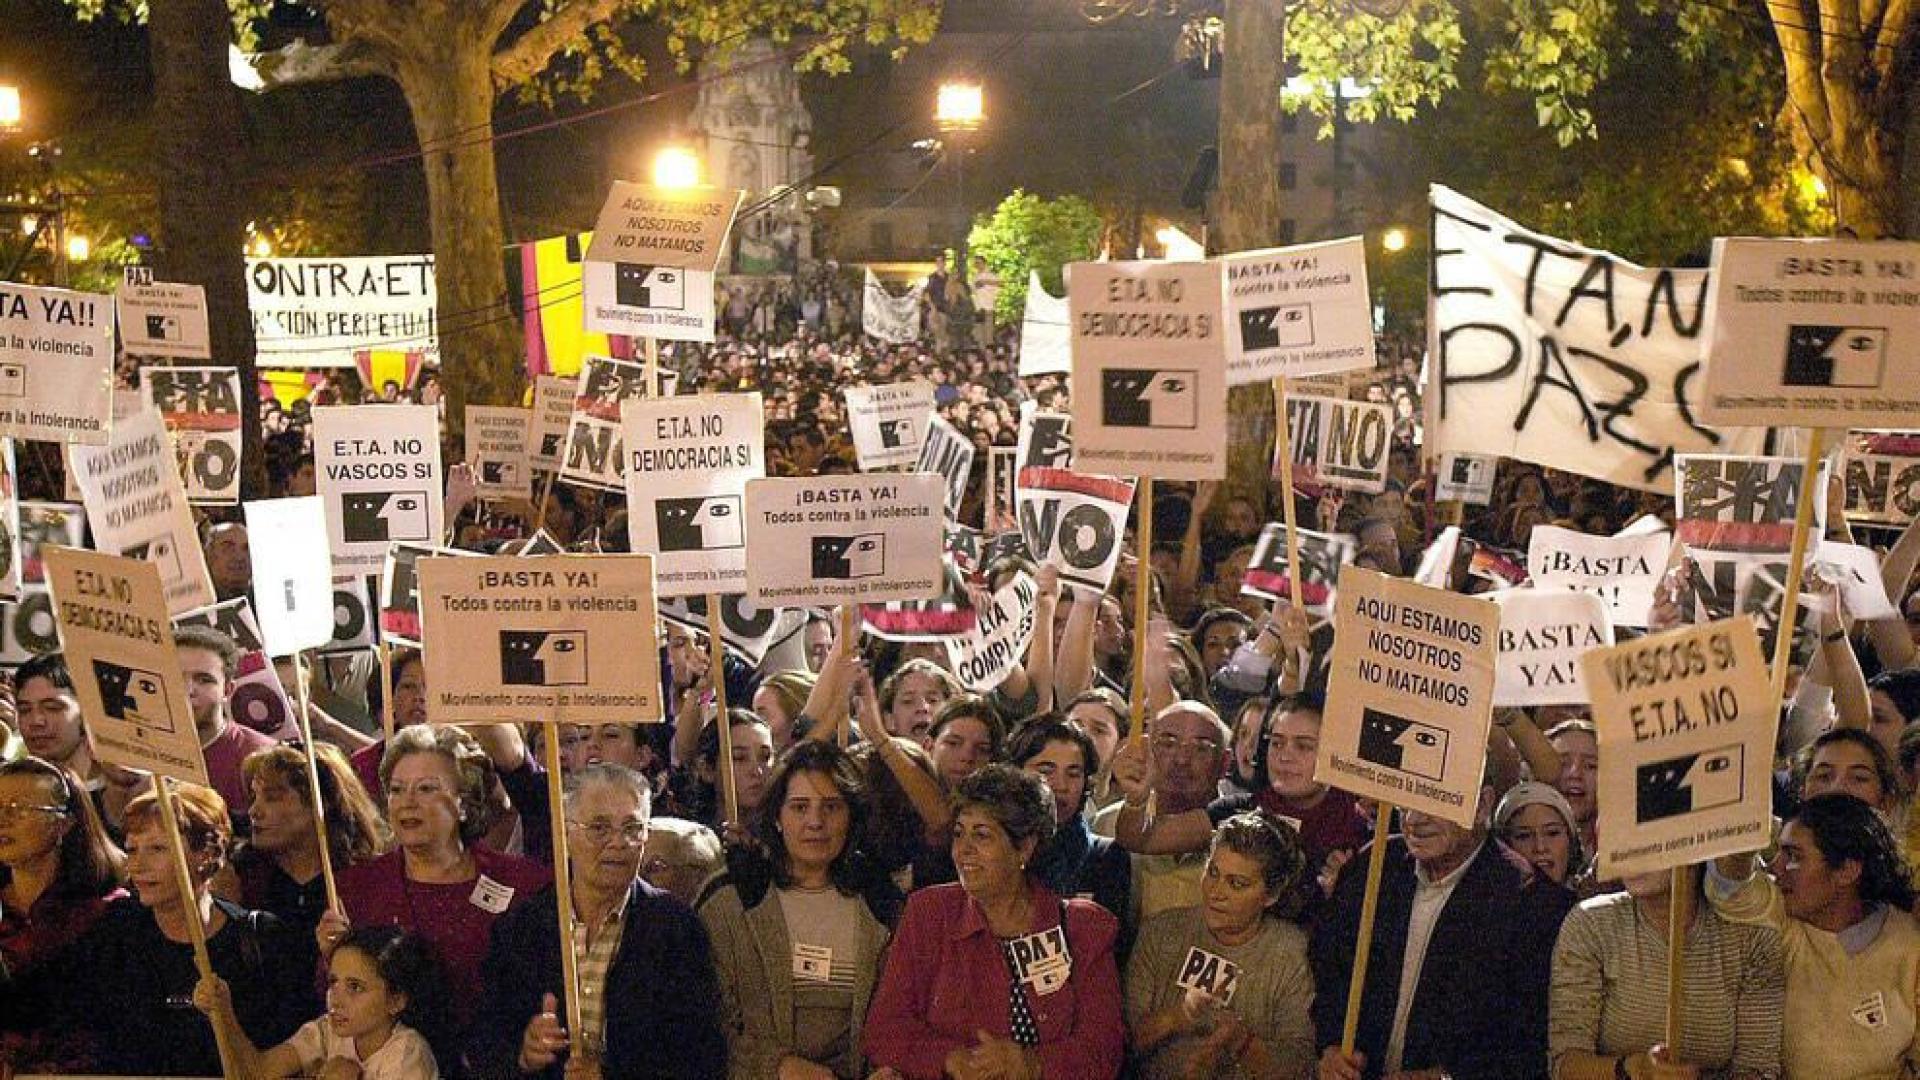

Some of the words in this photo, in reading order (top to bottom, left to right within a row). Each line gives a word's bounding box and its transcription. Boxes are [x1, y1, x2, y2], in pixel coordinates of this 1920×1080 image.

[627, 217, 704, 233] NOSOTROS
[615, 235, 635, 247] NO
[638, 237, 705, 252] MATAMOS
[1290, 256, 1318, 271] YA!
[126, 266, 152, 287] PAZ
[1157, 278, 1183, 302] NO
[41, 296, 94, 327] YA!!
[1081, 313, 1190, 337] DEMOCRACIA
[11, 334, 24, 349] la
[29, 337, 94, 357] violencia
[15, 408, 26, 425] la
[30, 411, 100, 431] Intolerancia
[656, 417, 697, 439] E.T.A.
[702, 415, 722, 436] NO
[334, 440, 387, 456] E.T.A.
[393, 439, 422, 455] NO
[1326, 404, 1386, 469] NO
[634, 445, 733, 472] DEMOCRACIA
[737, 444, 751, 466] SI
[326, 463, 408, 480] VASCOS
[415, 463, 432, 480] SI
[796, 489, 862, 507] ¡BASTA
[869, 486, 897, 499] YA!
[764, 511, 803, 524] Todos
[808, 509, 850, 523] contra
[855, 508, 866, 521] la
[871, 504, 930, 519] violencia
[1542, 551, 1651, 577] ¡BASTA
[478, 571, 555, 590] ¡BASTA
[565, 571, 598, 587] YA!
[759, 586, 819, 598] Movimiento
[824, 584, 856, 595] contra
[859, 582, 868, 592] la
[871, 580, 933, 592] Intolerancia
[441, 594, 489, 612] Todos
[493, 597, 543, 612] contra
[548, 597, 562, 612] la
[568, 596, 637, 612] violencia
[62, 601, 144, 638] DEMOCRACIA
[1356, 596, 1396, 624] AQUI
[1401, 606, 1482, 645] ESTAMOS
[1499, 623, 1602, 653] BASTA
[1368, 629, 1462, 672] NOSOTROS
[1520, 661, 1576, 688] YA!
[1605, 639, 1707, 693] VASCOS
[1709, 634, 1738, 670] SI
[1359, 658, 1381, 684] NO
[1386, 668, 1469, 707] MATAMOS
[441, 693, 512, 706] Movimiento
[557, 694, 569, 706] la
[574, 693, 648, 707] Intolerancia
[1629, 696, 1698, 742] E.T.A.
[1702, 686, 1739, 727] NO
[1330, 754, 1376, 781] Movimiento
[1376, 767, 1404, 789] contra
[1406, 775, 1414, 792] la
[1415, 779, 1465, 808] Intolerancia
[1666, 833, 1694, 852] contra
[1696, 832, 1705, 847] la
[1706, 821, 1762, 842] Intolerancia
[1012, 930, 1065, 977] PAZ
[1181, 949, 1237, 1001] PAZ
